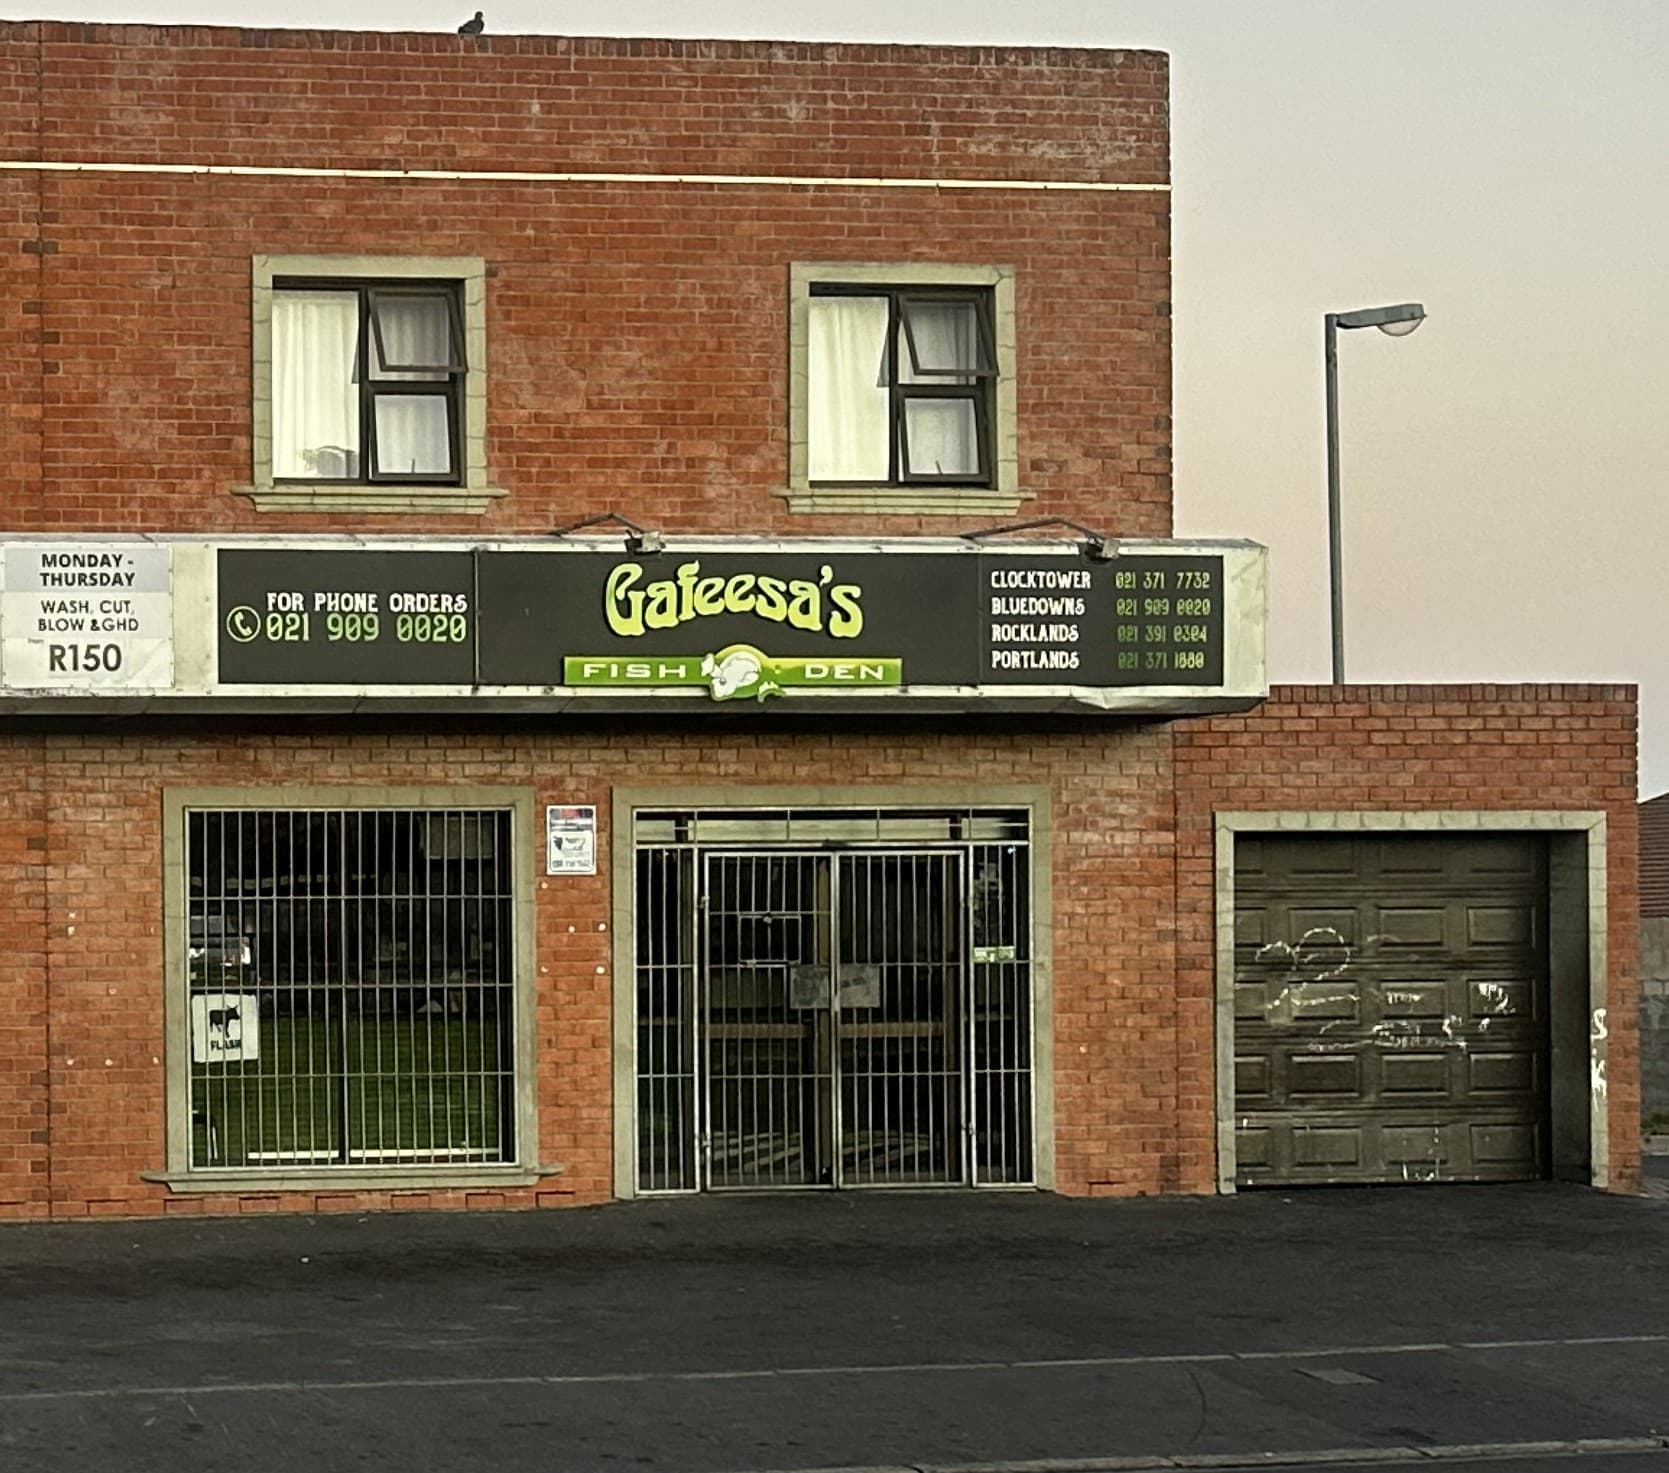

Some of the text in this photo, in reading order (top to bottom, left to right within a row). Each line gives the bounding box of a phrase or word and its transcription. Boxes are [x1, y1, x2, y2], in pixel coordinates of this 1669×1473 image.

[41, 553, 124, 568] MONDAY
[39, 572, 136, 587] THURSDAY
[990, 570, 1210, 589] CLOCKTOWER 021 371 7732
[266, 592, 468, 613] FOR PHONE ORDERS
[605, 560, 863, 638] Gafeesa's
[991, 597, 1086, 616] BLUEDOWNS
[1116, 598, 1137, 616] 021
[38, 618, 85, 632] BLOW
[266, 612, 467, 643] 021 909 0020
[991, 623, 1079, 642] ROCKLANDS
[1117, 624, 1139, 642] 021
[1144, 624, 1167, 643] 391
[49, 643, 122, 672] R150
[991, 650, 1080, 669] PORTLANDS
[1118, 651, 1139, 669] 021
[1144, 651, 1168, 669] 371
[582, 663, 884, 680] FISH DEN
